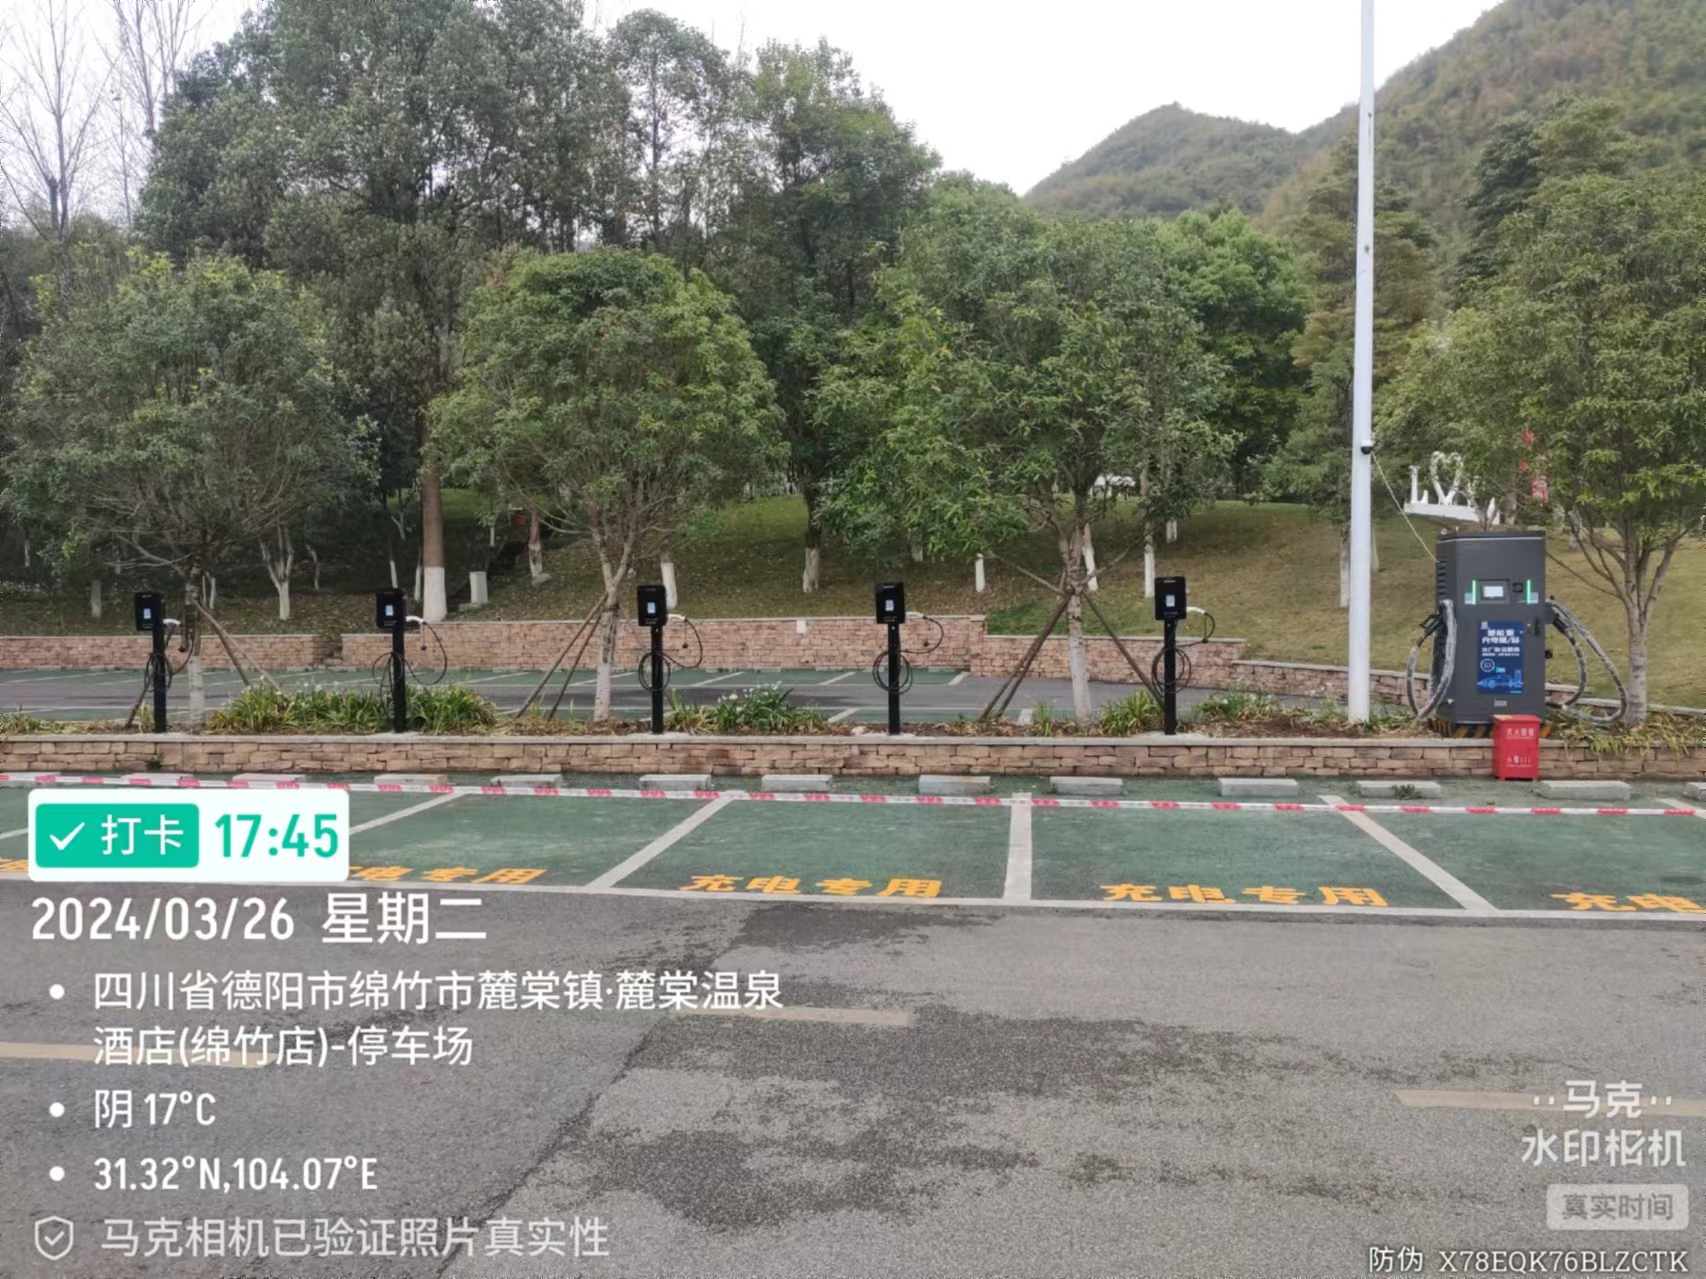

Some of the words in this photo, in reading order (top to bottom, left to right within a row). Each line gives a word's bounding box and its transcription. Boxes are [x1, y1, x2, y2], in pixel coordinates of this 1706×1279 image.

[679, 874, 942, 898] 充电专用
[1100, 883, 1388, 907] 充电专用
